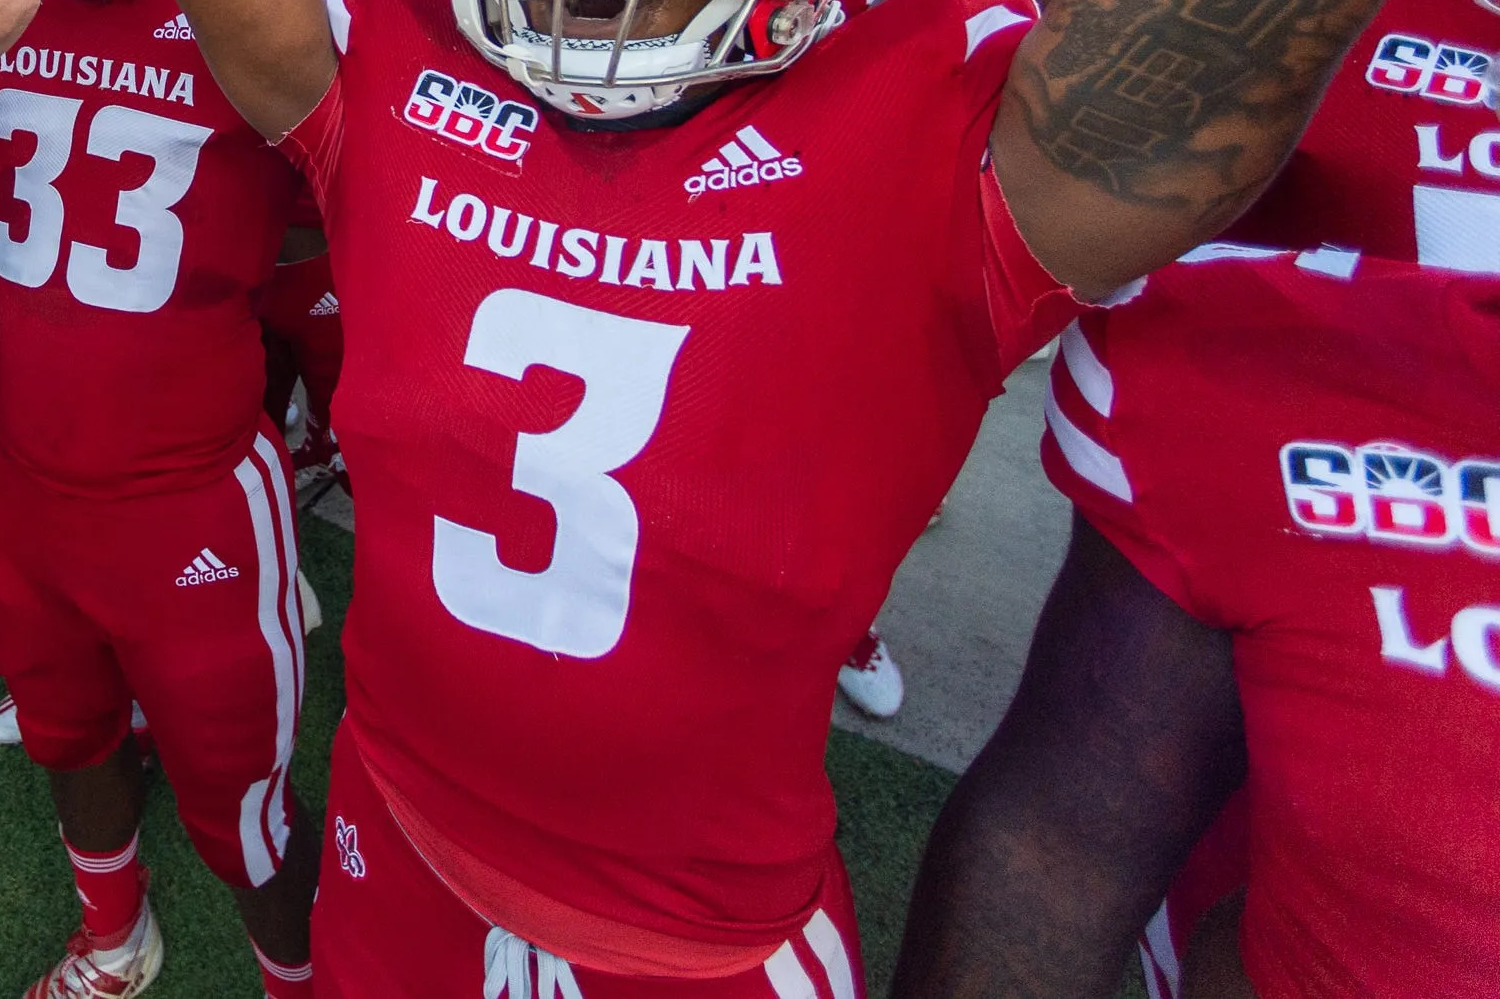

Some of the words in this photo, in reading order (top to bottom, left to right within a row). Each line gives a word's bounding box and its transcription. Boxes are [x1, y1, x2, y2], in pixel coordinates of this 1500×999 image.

[152, 25, 196, 41] adid
[0, 45, 195, 107] LOUISIANA
[403, 68, 540, 163] SBC
[682, 154, 805, 195] adidas
[409, 175, 784, 292] LOUISIANA
[431, 287, 692, 660] 3
[174, 564, 241, 588] adidas
